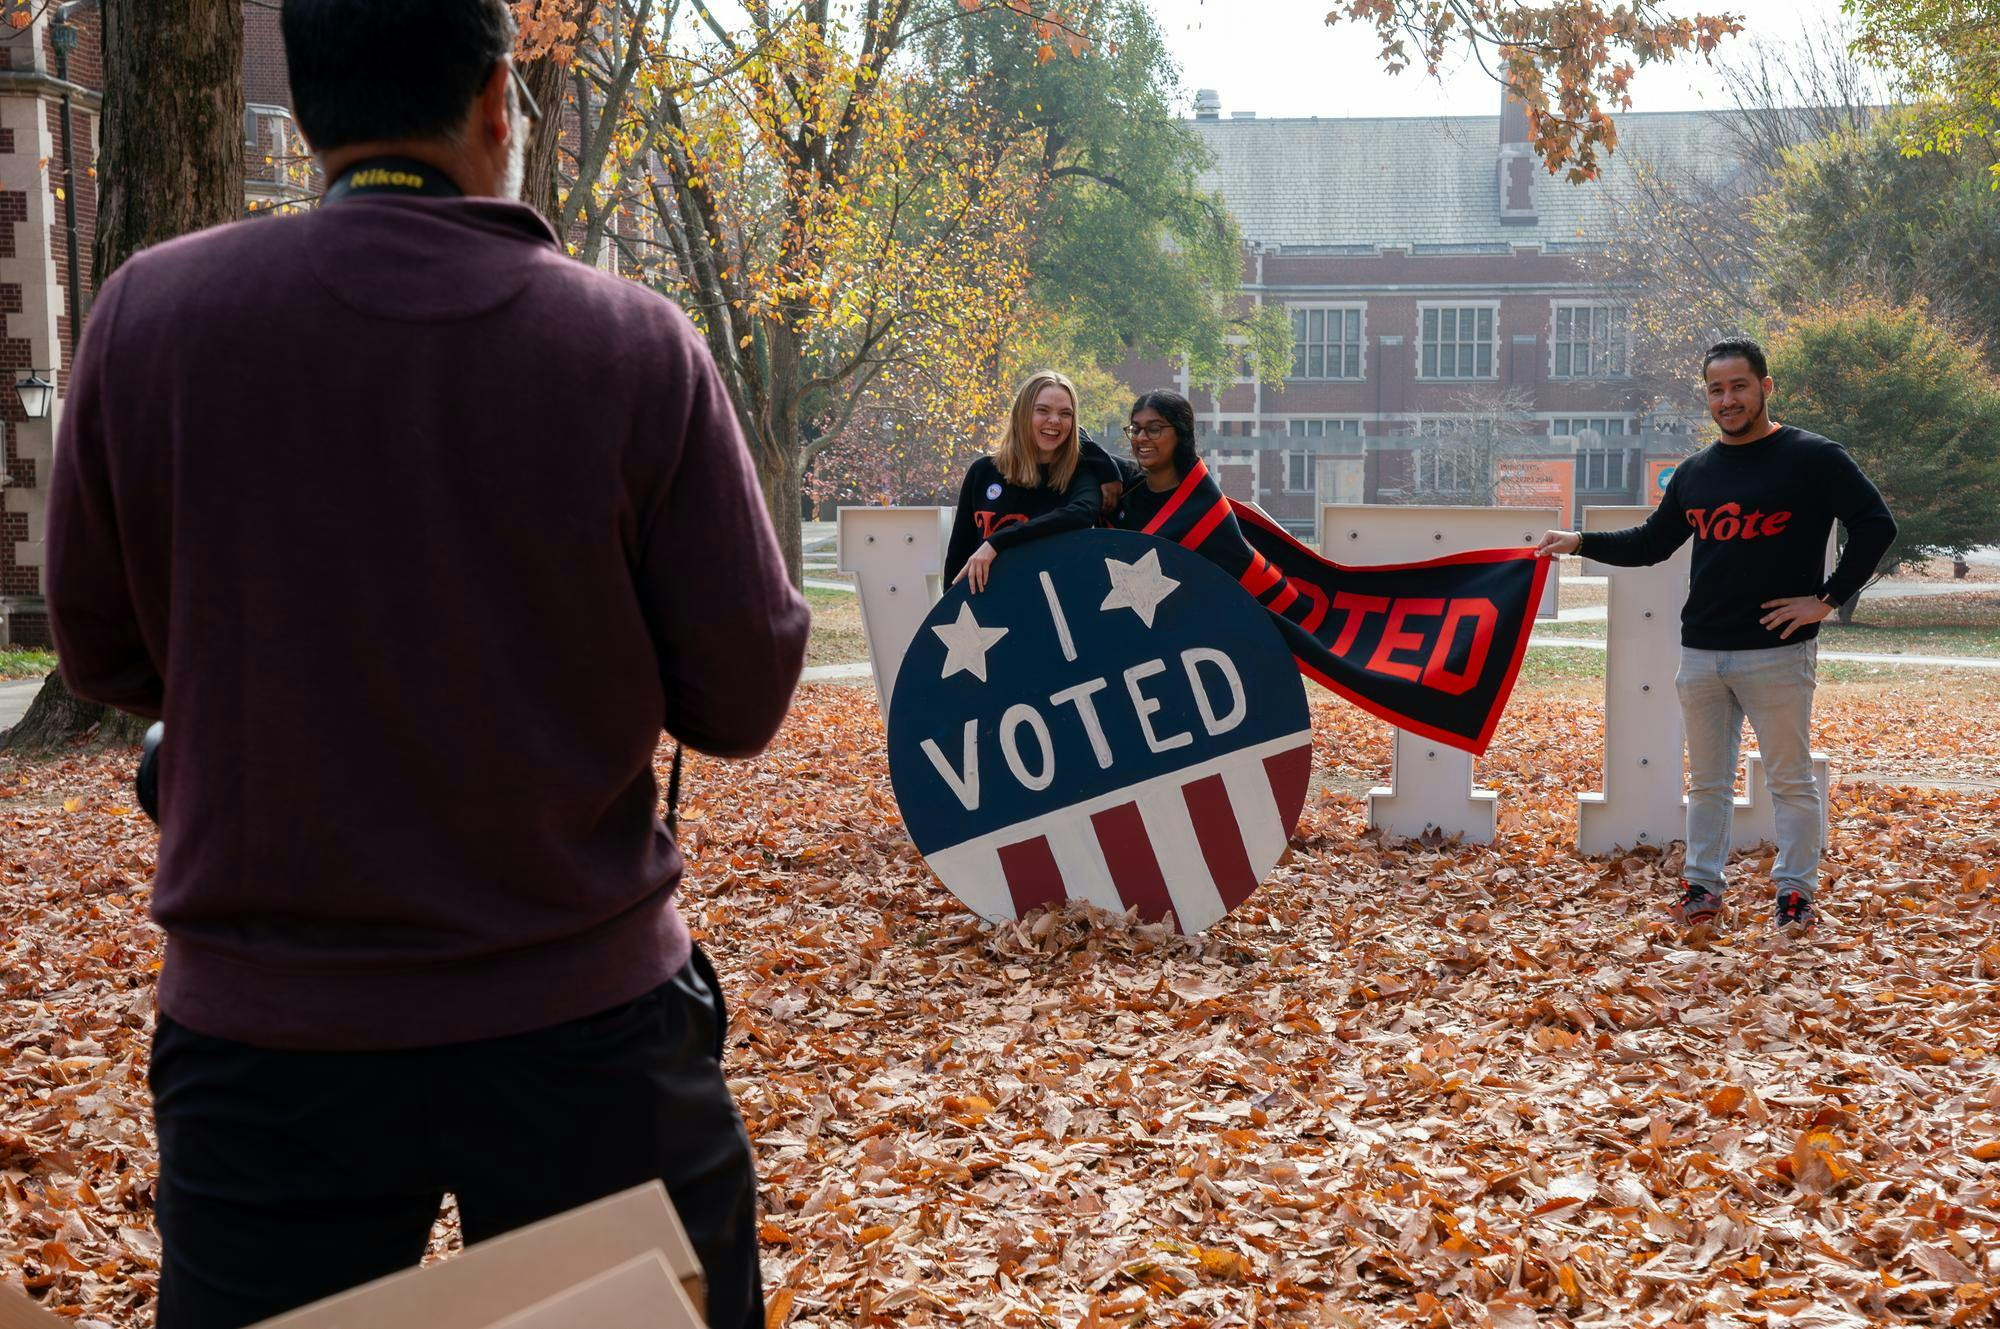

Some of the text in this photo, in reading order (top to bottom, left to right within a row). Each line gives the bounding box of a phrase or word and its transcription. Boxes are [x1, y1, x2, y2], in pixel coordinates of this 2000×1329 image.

[350, 169, 423, 189] Nikon
[1685, 502, 1793, 540] Vote
[1039, 571, 1078, 662] I
[919, 647, 1247, 811] VOTED
